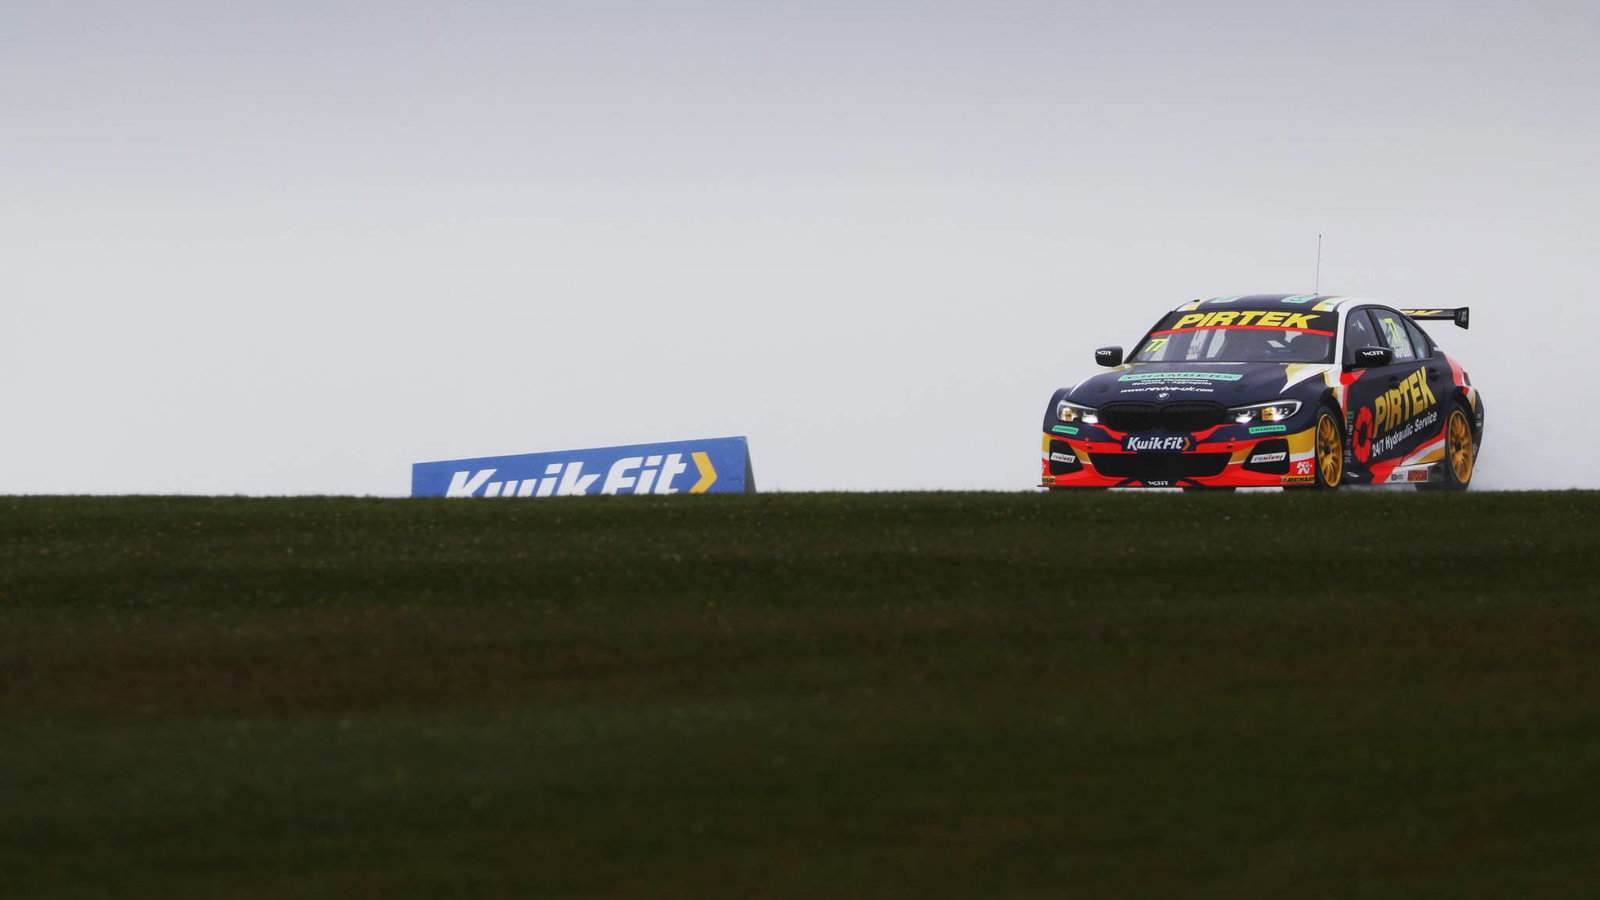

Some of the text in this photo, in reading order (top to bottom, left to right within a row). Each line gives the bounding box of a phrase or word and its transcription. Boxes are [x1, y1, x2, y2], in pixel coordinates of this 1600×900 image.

[1172, 312, 1320, 329] PIRTEK
[1145, 339, 1168, 352] 77
[1373, 366, 1436, 439] PIRTEK
[1372, 439, 1384, 457] 24/7
[1385, 424, 1413, 449] Hydraulic
[1414, 412, 1437, 431] Service
